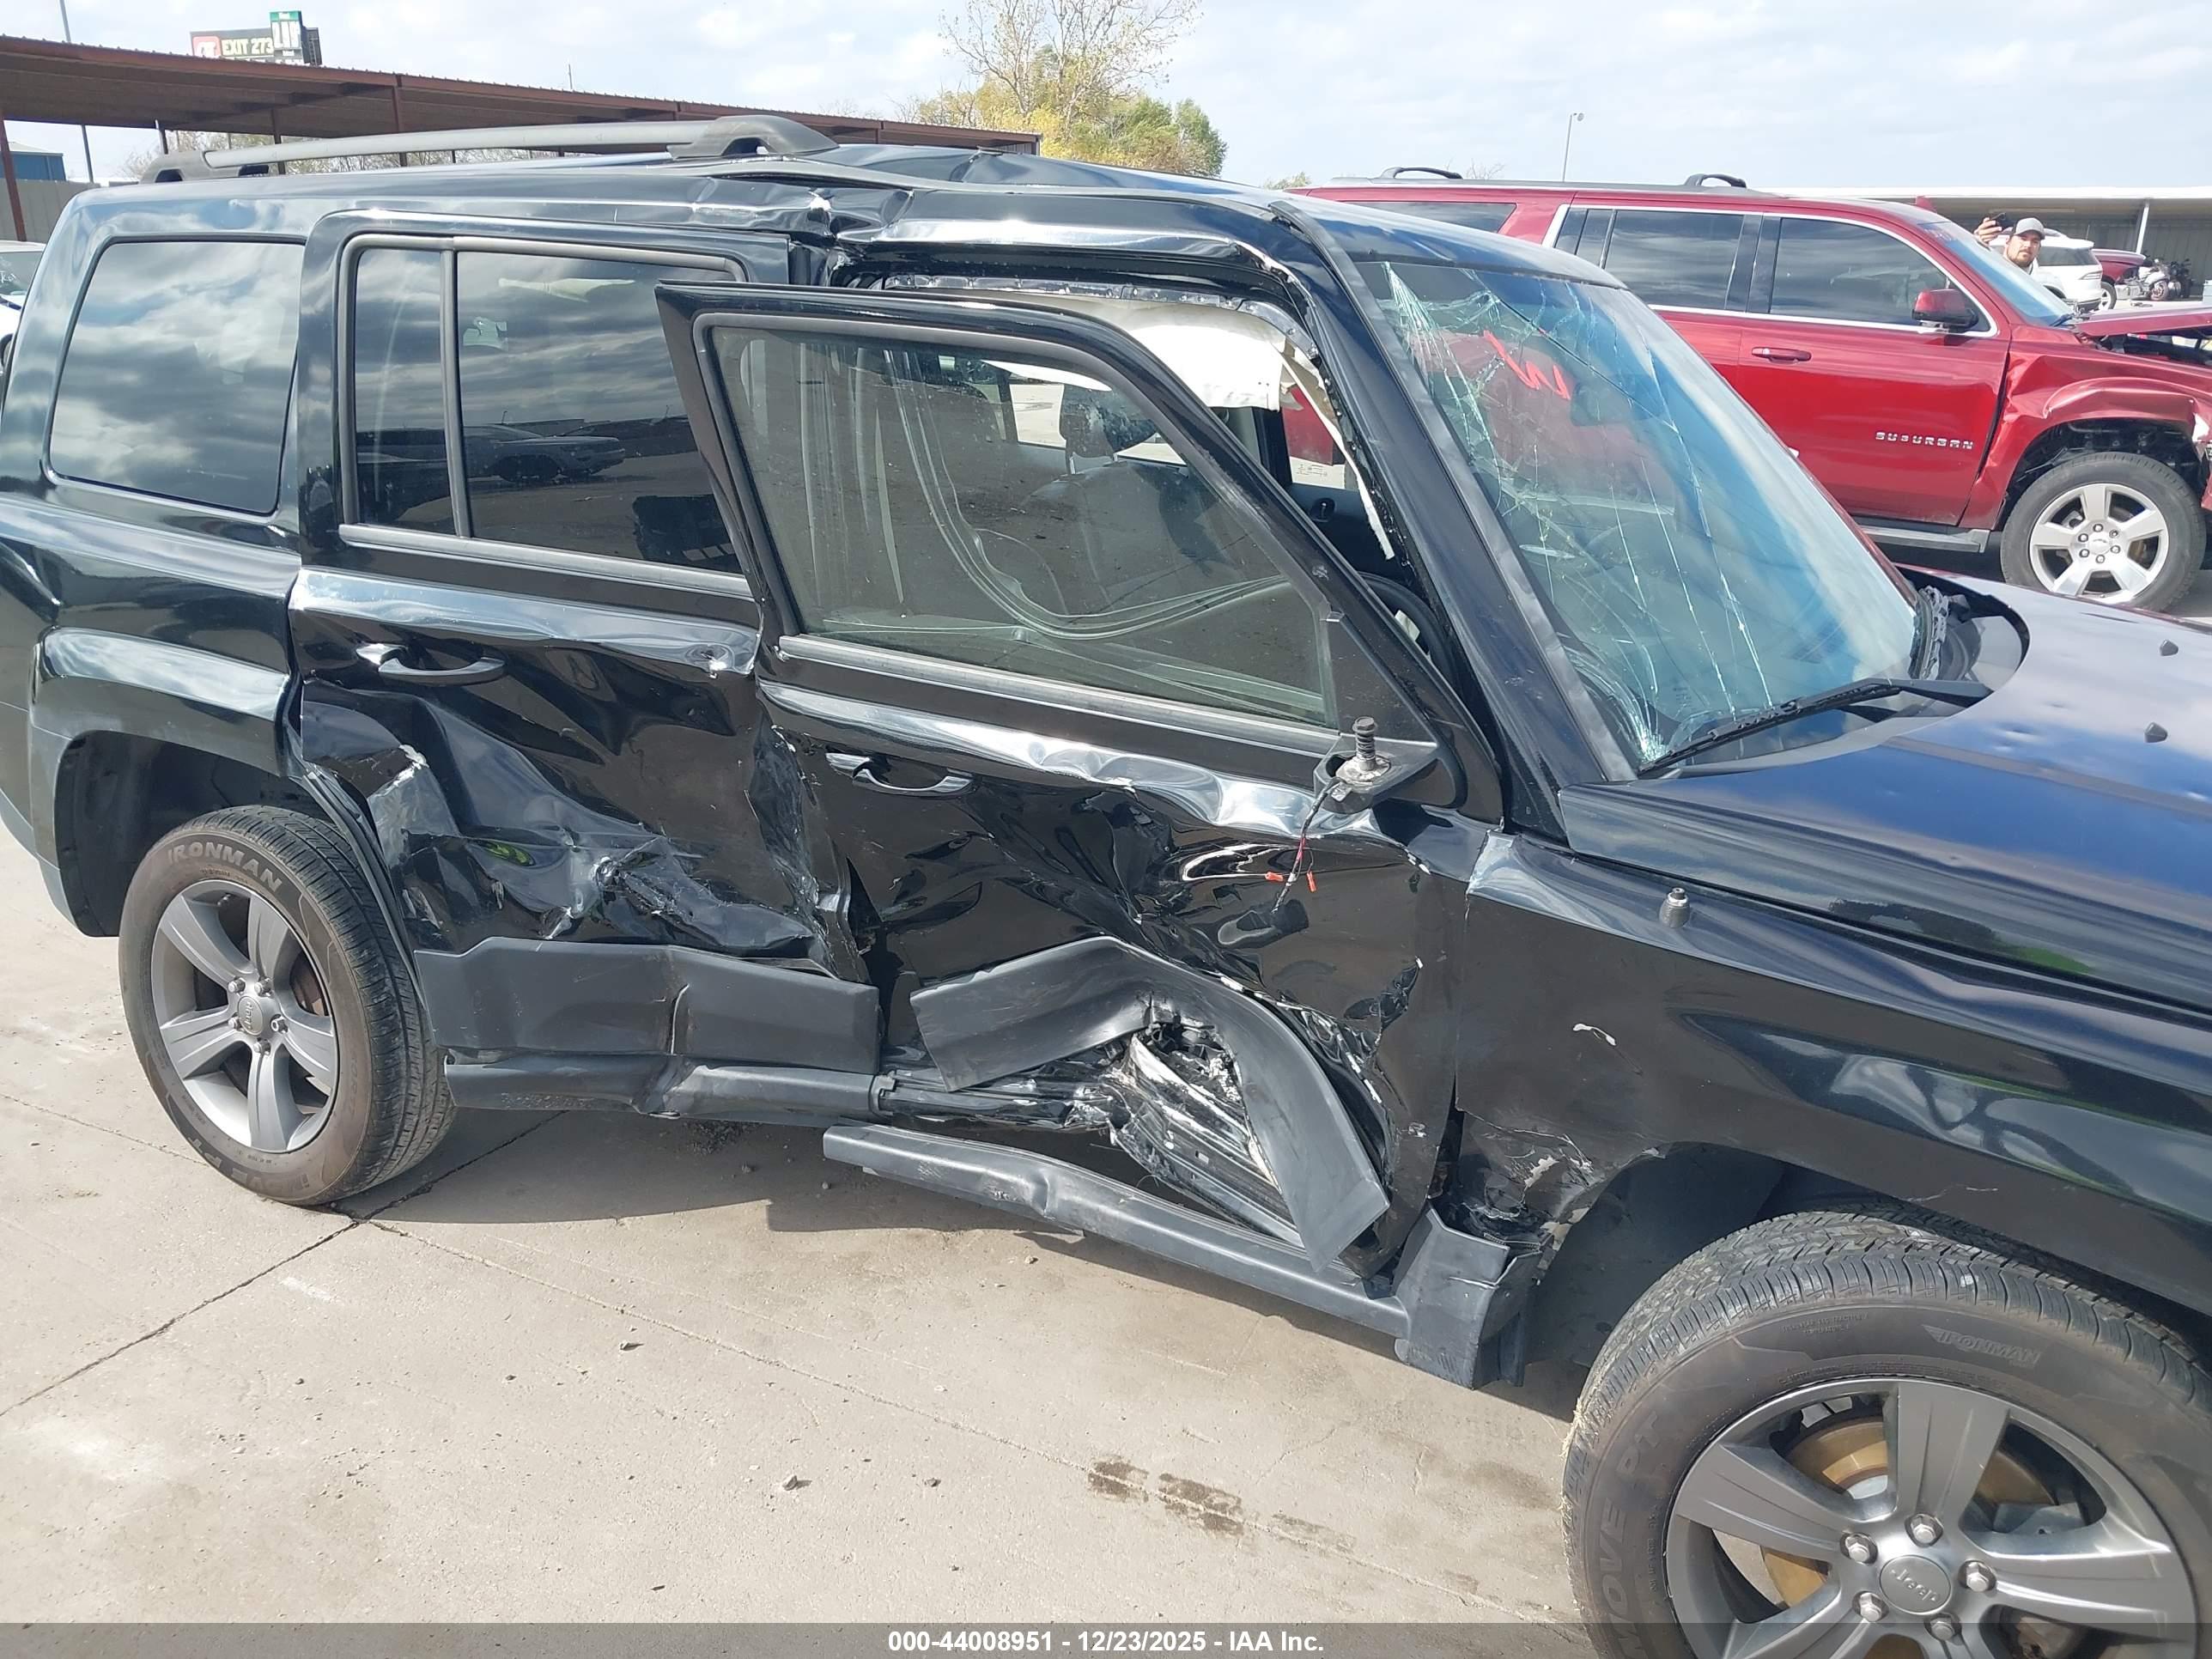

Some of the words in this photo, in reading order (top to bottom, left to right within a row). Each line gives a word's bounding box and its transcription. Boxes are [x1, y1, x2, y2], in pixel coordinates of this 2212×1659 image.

[221, 38, 249, 56] EXIT
[251, 37, 274, 54] 273
[1875, 431, 1973, 449] SUBURBAN
[168, 841, 282, 890] IRONMAN
[1889, 1566, 1939, 1603] Jeep
